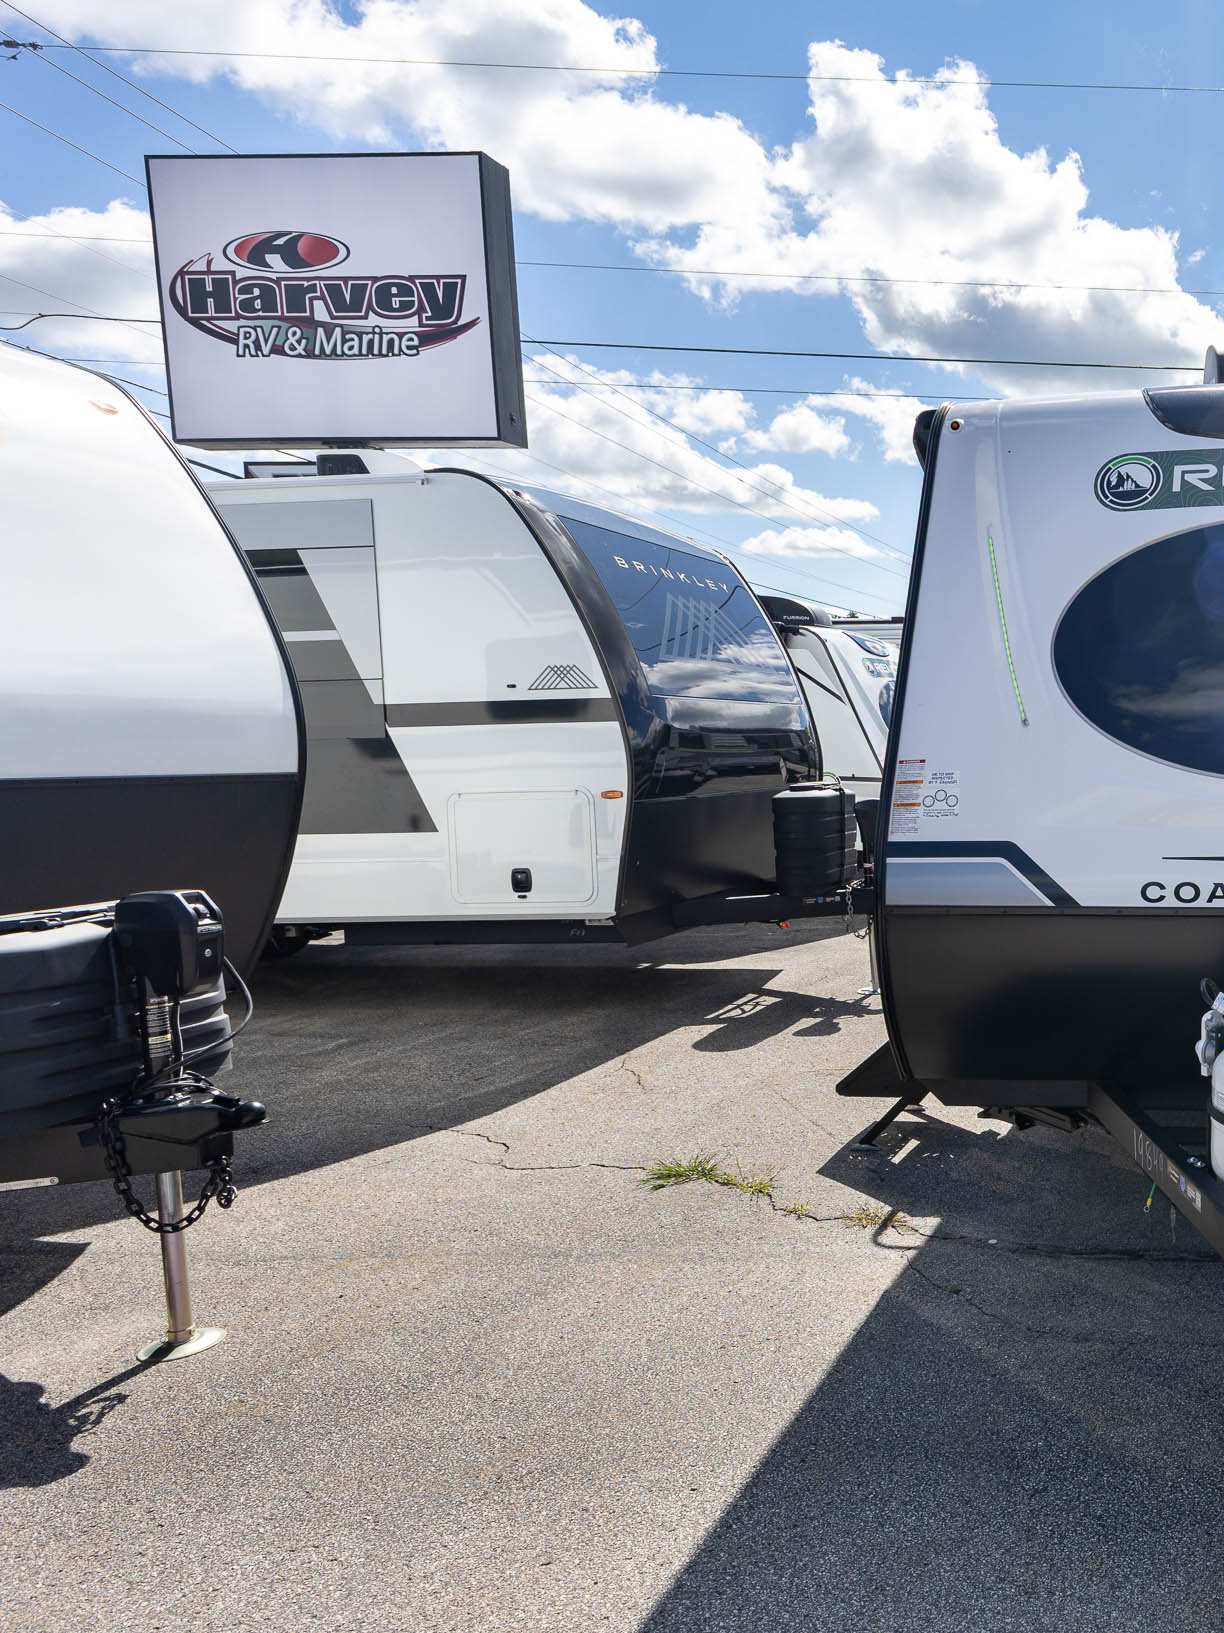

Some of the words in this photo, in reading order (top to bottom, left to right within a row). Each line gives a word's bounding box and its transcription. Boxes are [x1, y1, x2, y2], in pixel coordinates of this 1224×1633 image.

[181, 271, 466, 327] Harvey
[236, 326, 279, 357] RV
[284, 326, 308, 356] &
[313, 326, 420, 357] Marine
[613, 555, 730, 593] BRINKLEY
